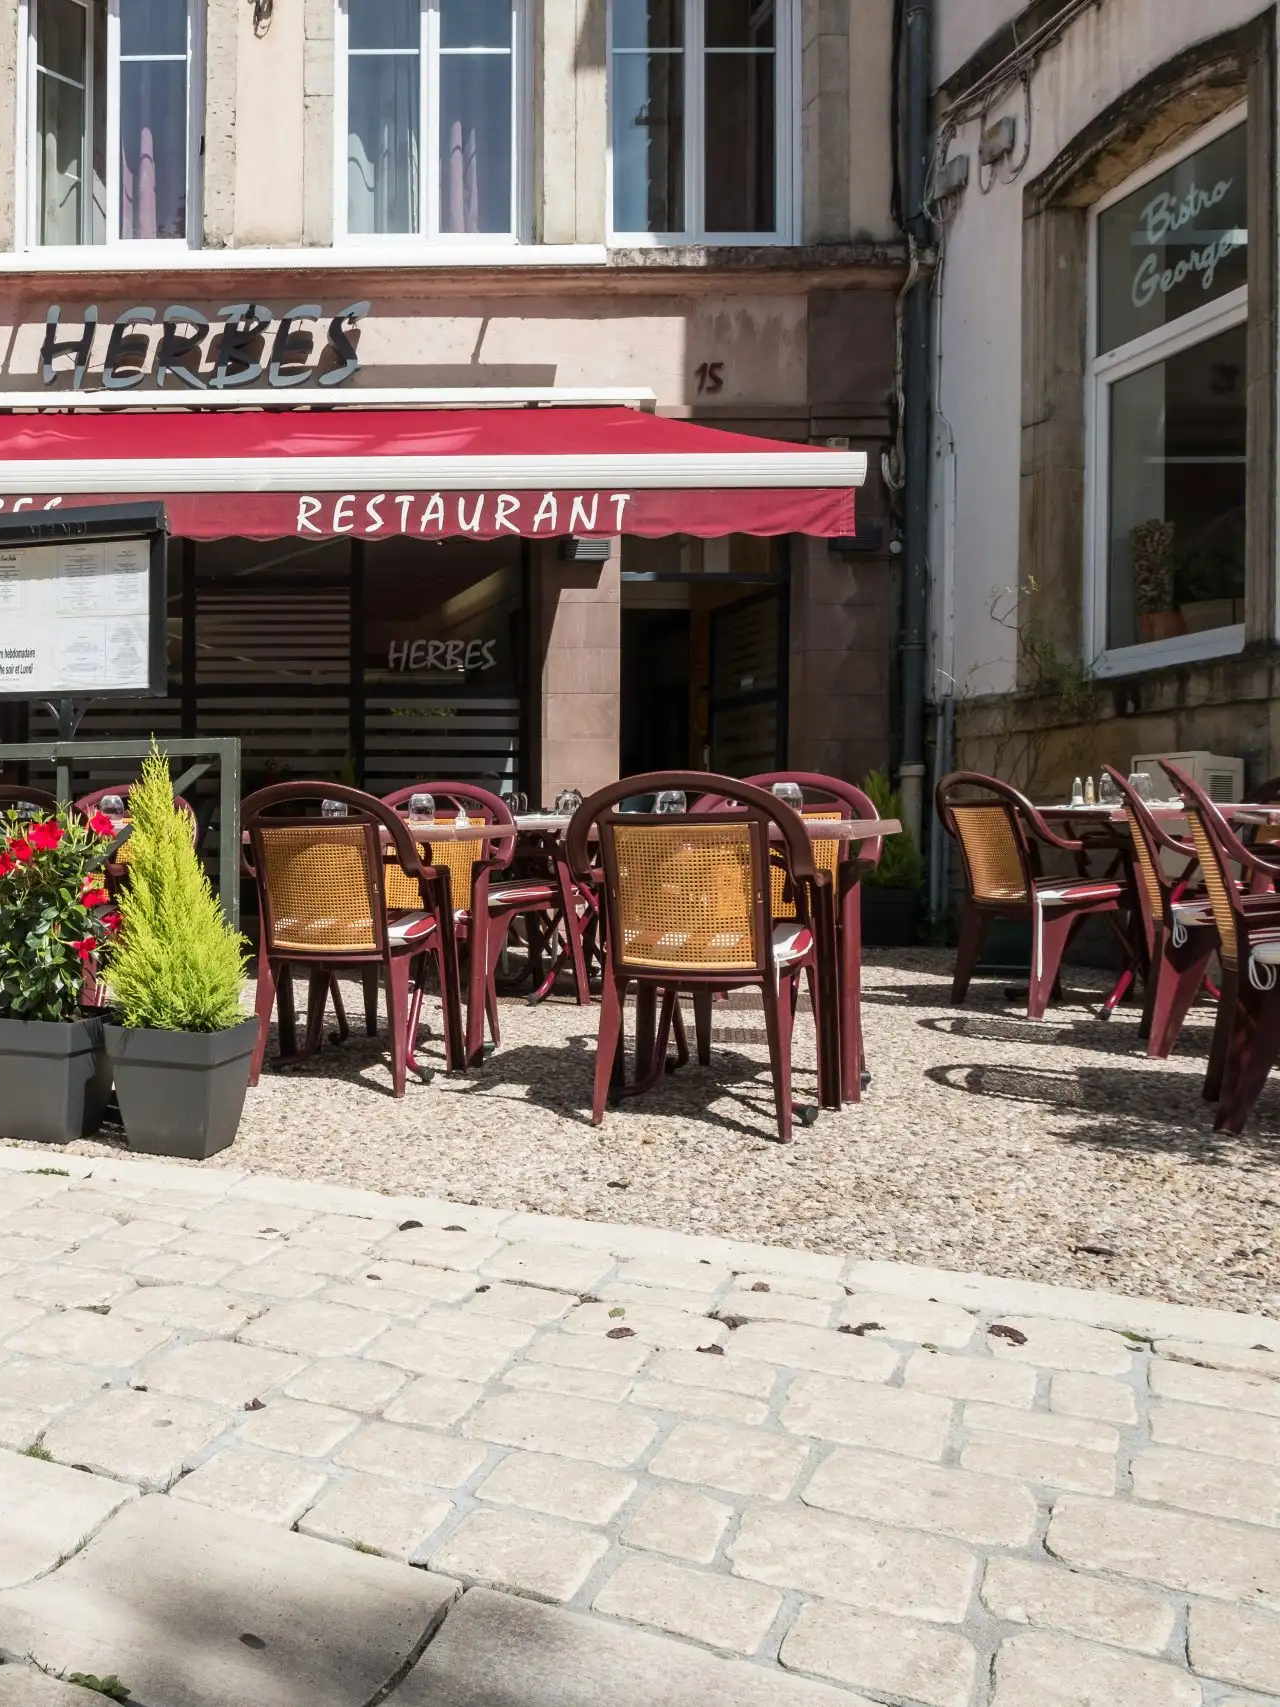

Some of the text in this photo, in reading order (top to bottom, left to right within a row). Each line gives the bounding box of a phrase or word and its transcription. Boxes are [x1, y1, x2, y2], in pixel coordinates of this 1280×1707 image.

[1141, 178, 1234, 245] Bistro
[40, 301, 372, 390] HERBES
[693, 361, 725, 397] 15
[296, 491, 631, 534] RESTAURANT
[387, 639, 498, 672] HERBES
